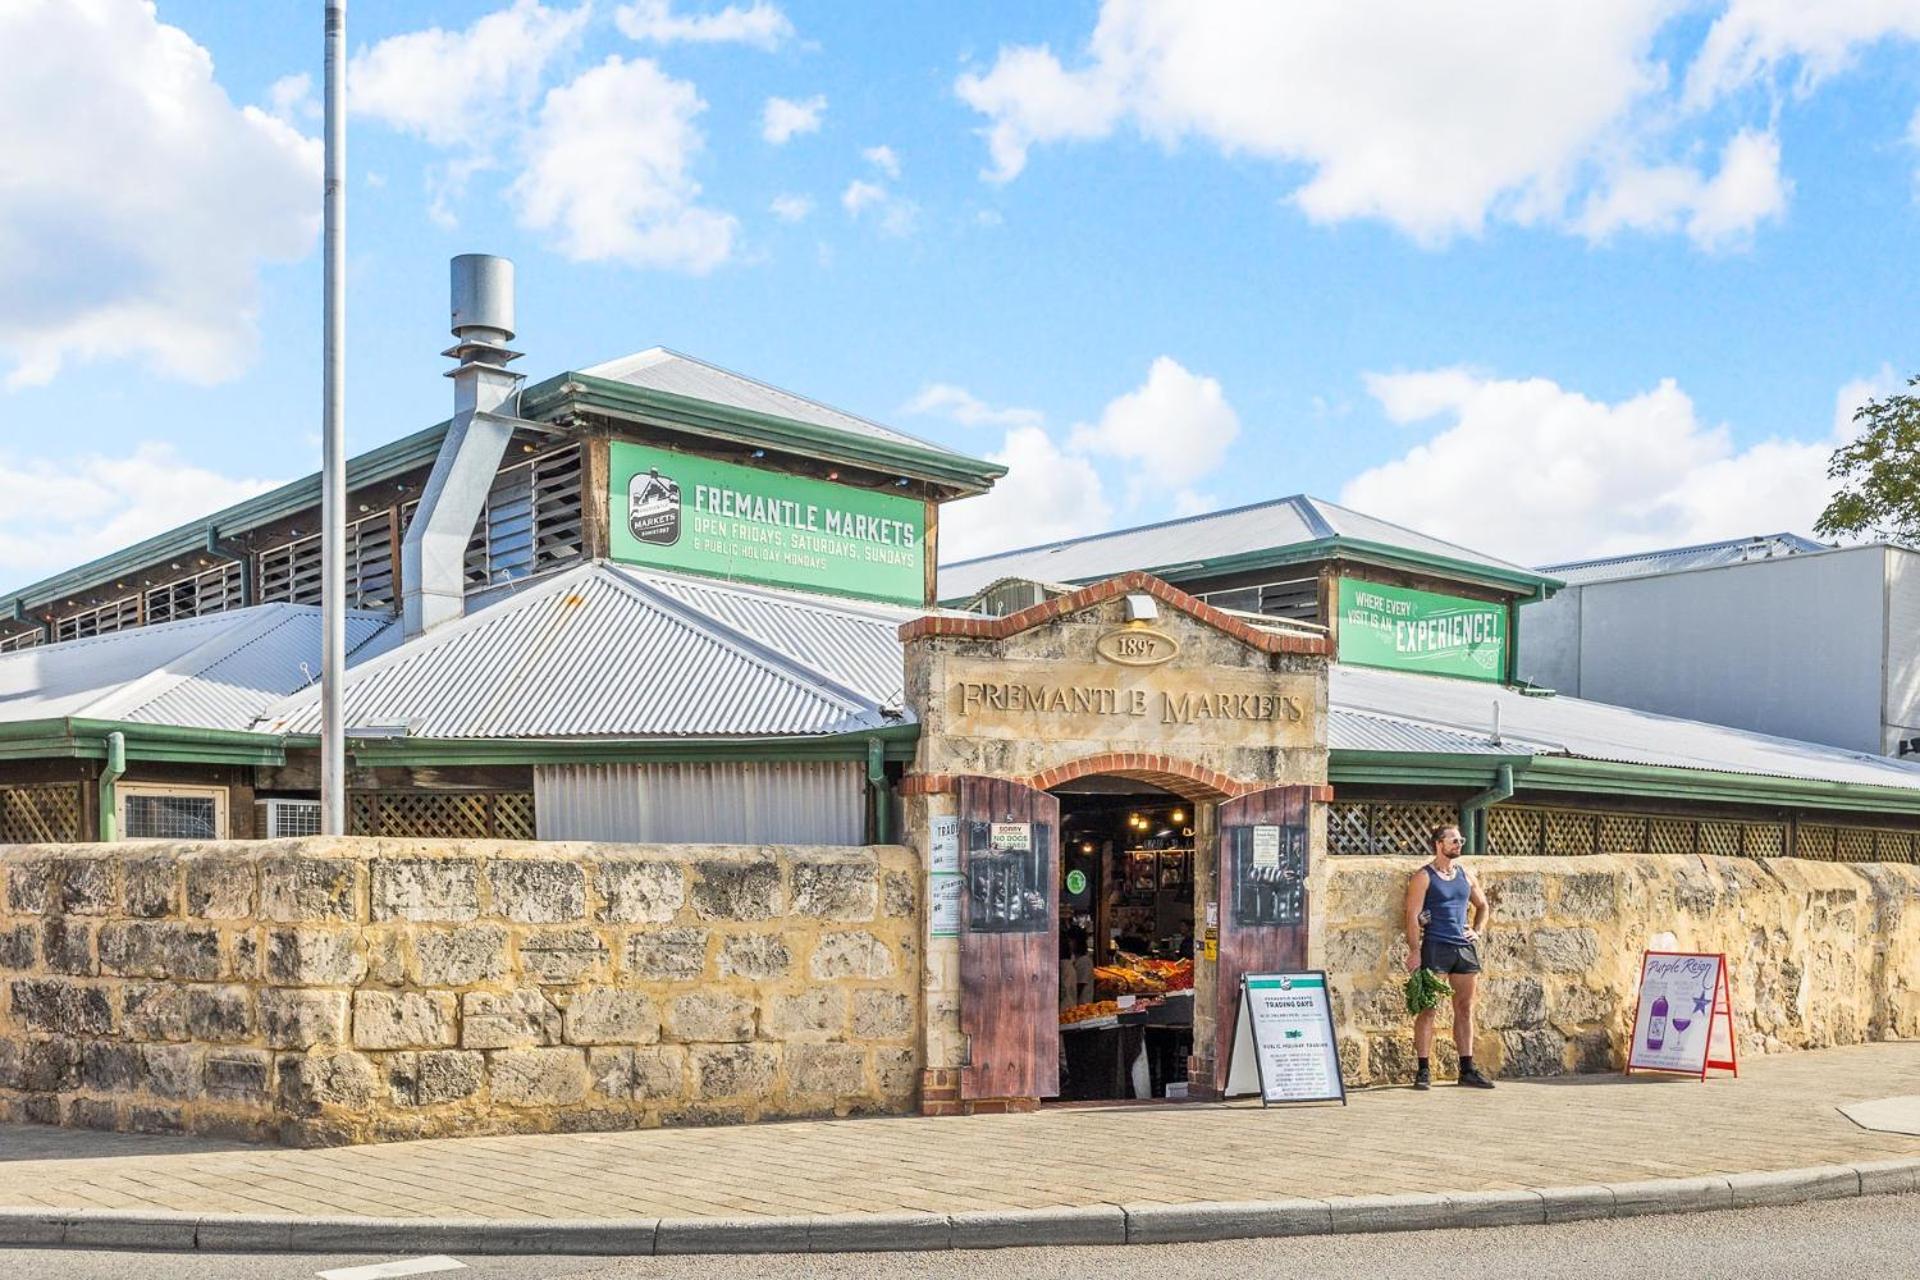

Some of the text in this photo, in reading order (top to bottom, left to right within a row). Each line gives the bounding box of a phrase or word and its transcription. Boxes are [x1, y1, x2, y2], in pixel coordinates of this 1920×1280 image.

[694, 484, 915, 549] FREMANTLE MARKETS
[694, 517, 727, 537] OPEN
[864, 546, 915, 569] SUNDAYS
[704, 539, 739, 557] PUBLIC
[742, 544, 780, 562] HOLIDAY
[783, 552, 827, 570] MONDAYS
[1355, 591, 1412, 617] WHERE EVERY
[1347, 608, 1392, 632] VISIT IS AN
[1396, 612, 1498, 652] EXPERIENCE!
[1118, 637, 1157, 657] 1897
[959, 682, 1305, 725] FREMANTLE MARKETS
[1647, 958, 1681, 979] Purple
[1681, 959, 1713, 989] Reign
